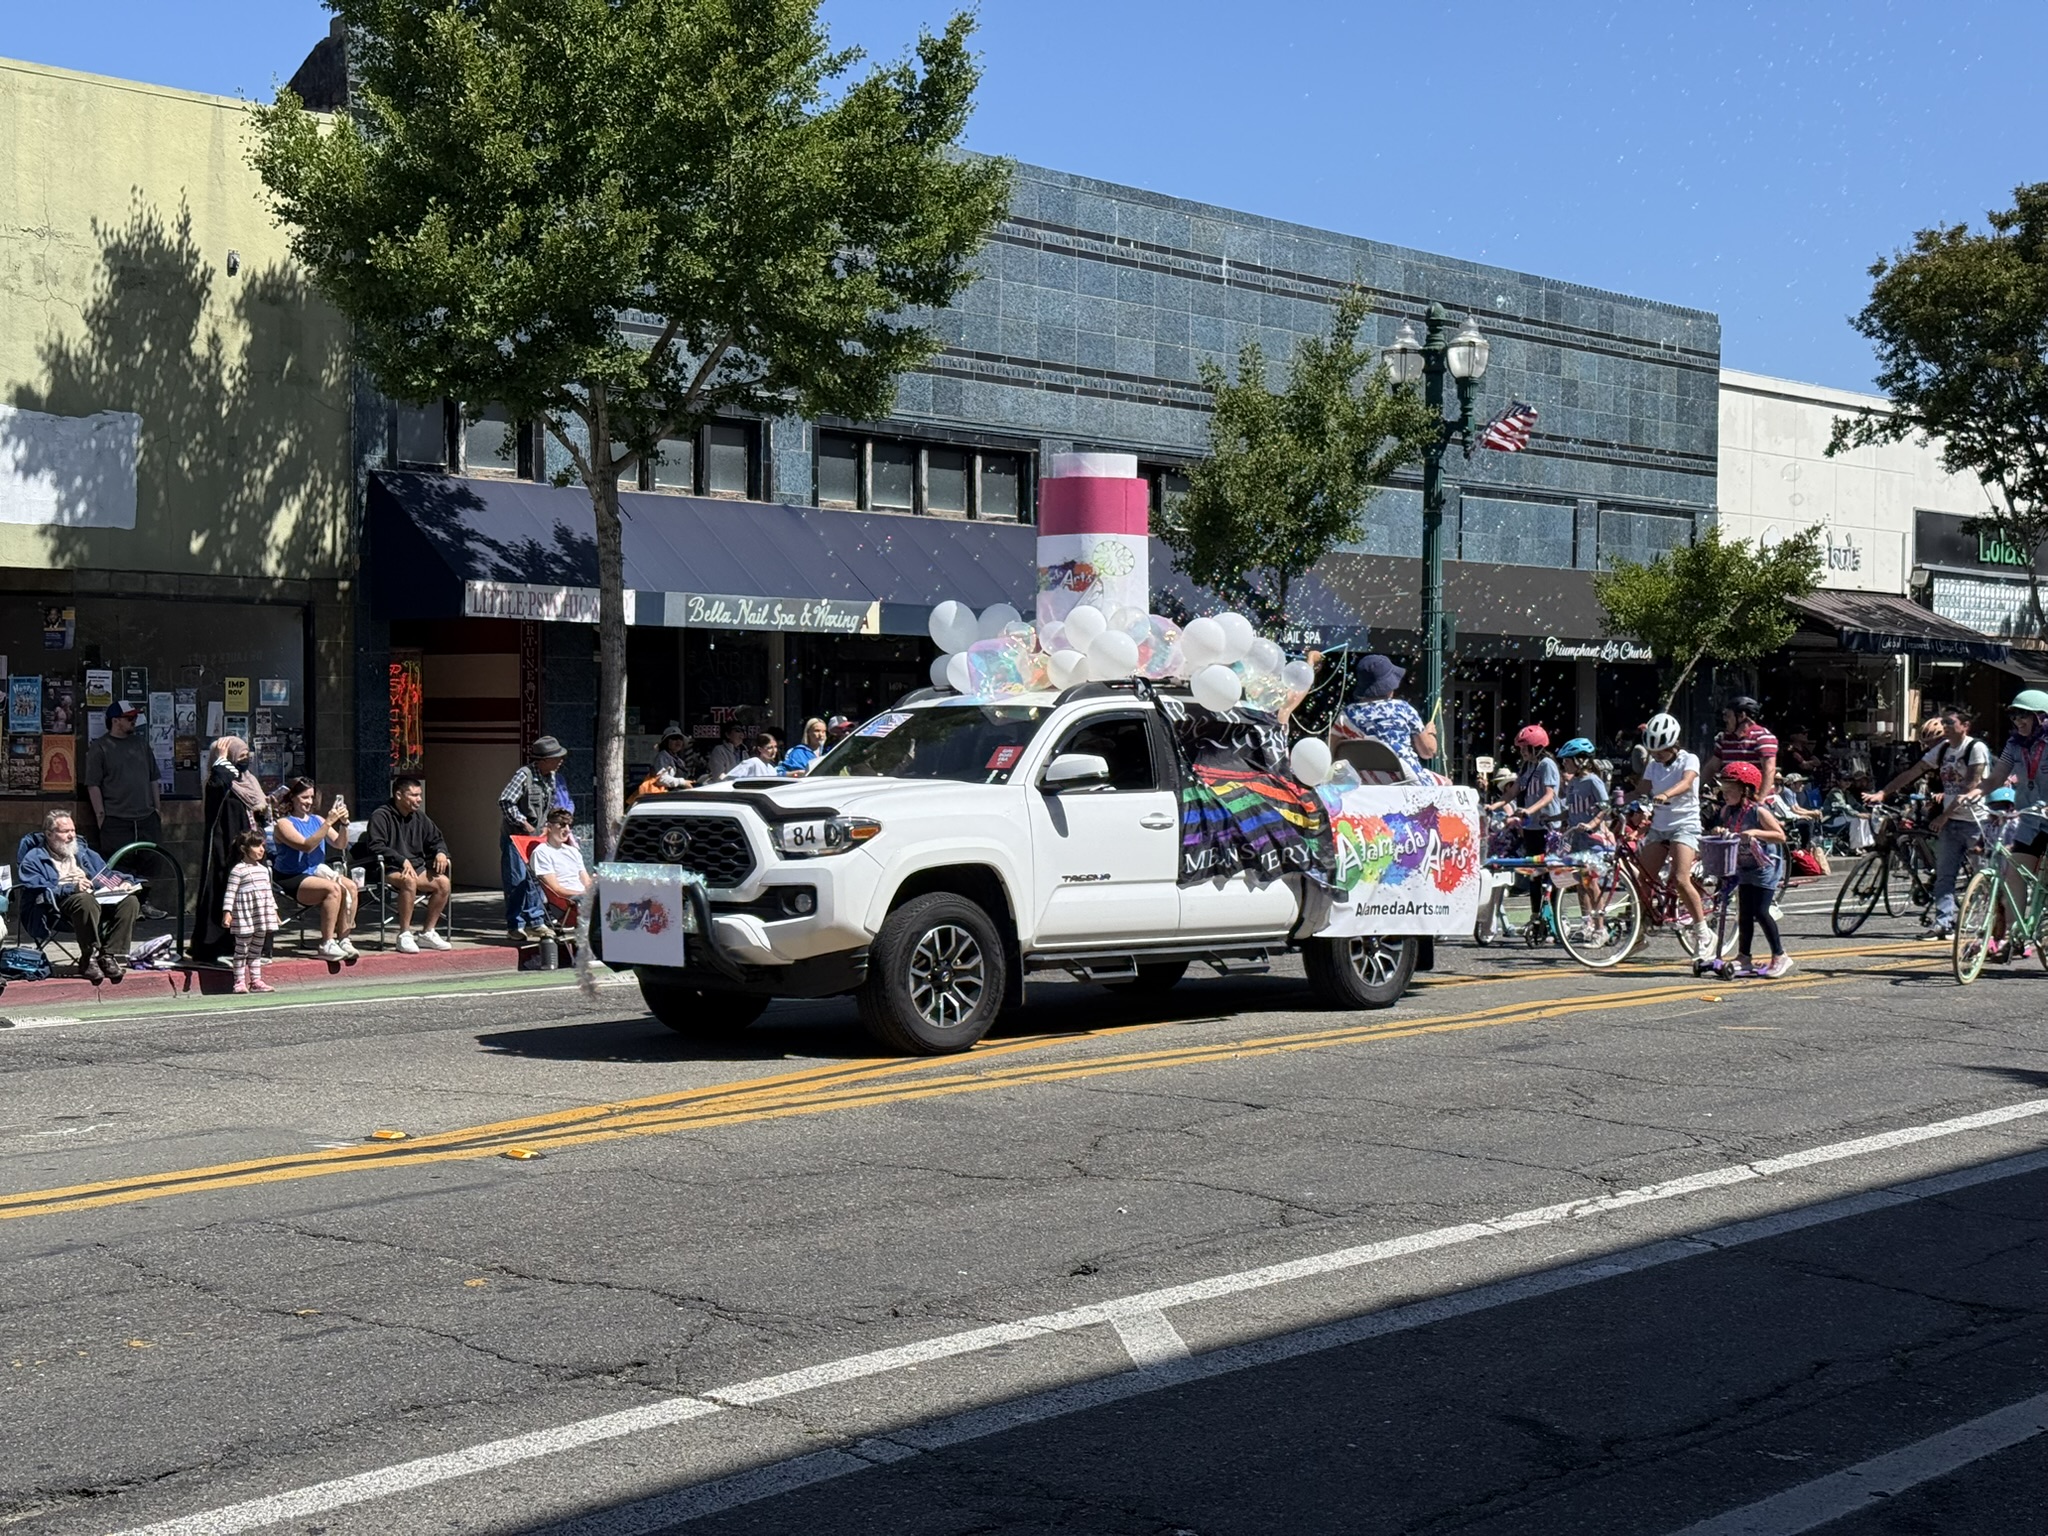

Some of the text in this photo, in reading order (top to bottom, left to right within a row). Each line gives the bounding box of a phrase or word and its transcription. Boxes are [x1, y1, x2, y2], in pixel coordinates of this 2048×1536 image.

[1059, 569, 1093, 590] Arts
[473, 589, 525, 617] LITTLE
[687, 596, 860, 633] Bella Nail Spa & Waxing
[1303, 630, 1321, 645] SPA
[1545, 635, 1601, 660] Triumphant
[1620, 641, 1654, 661] Church
[228, 680, 246, 689] IMP
[709, 706, 738, 724] TK
[1455, 790, 1470, 806] 84
[793, 825, 816, 847] 84
[1336, 822, 1470, 883] Alameda Arts
[1355, 900, 1450, 918] AlamedaArts.com
